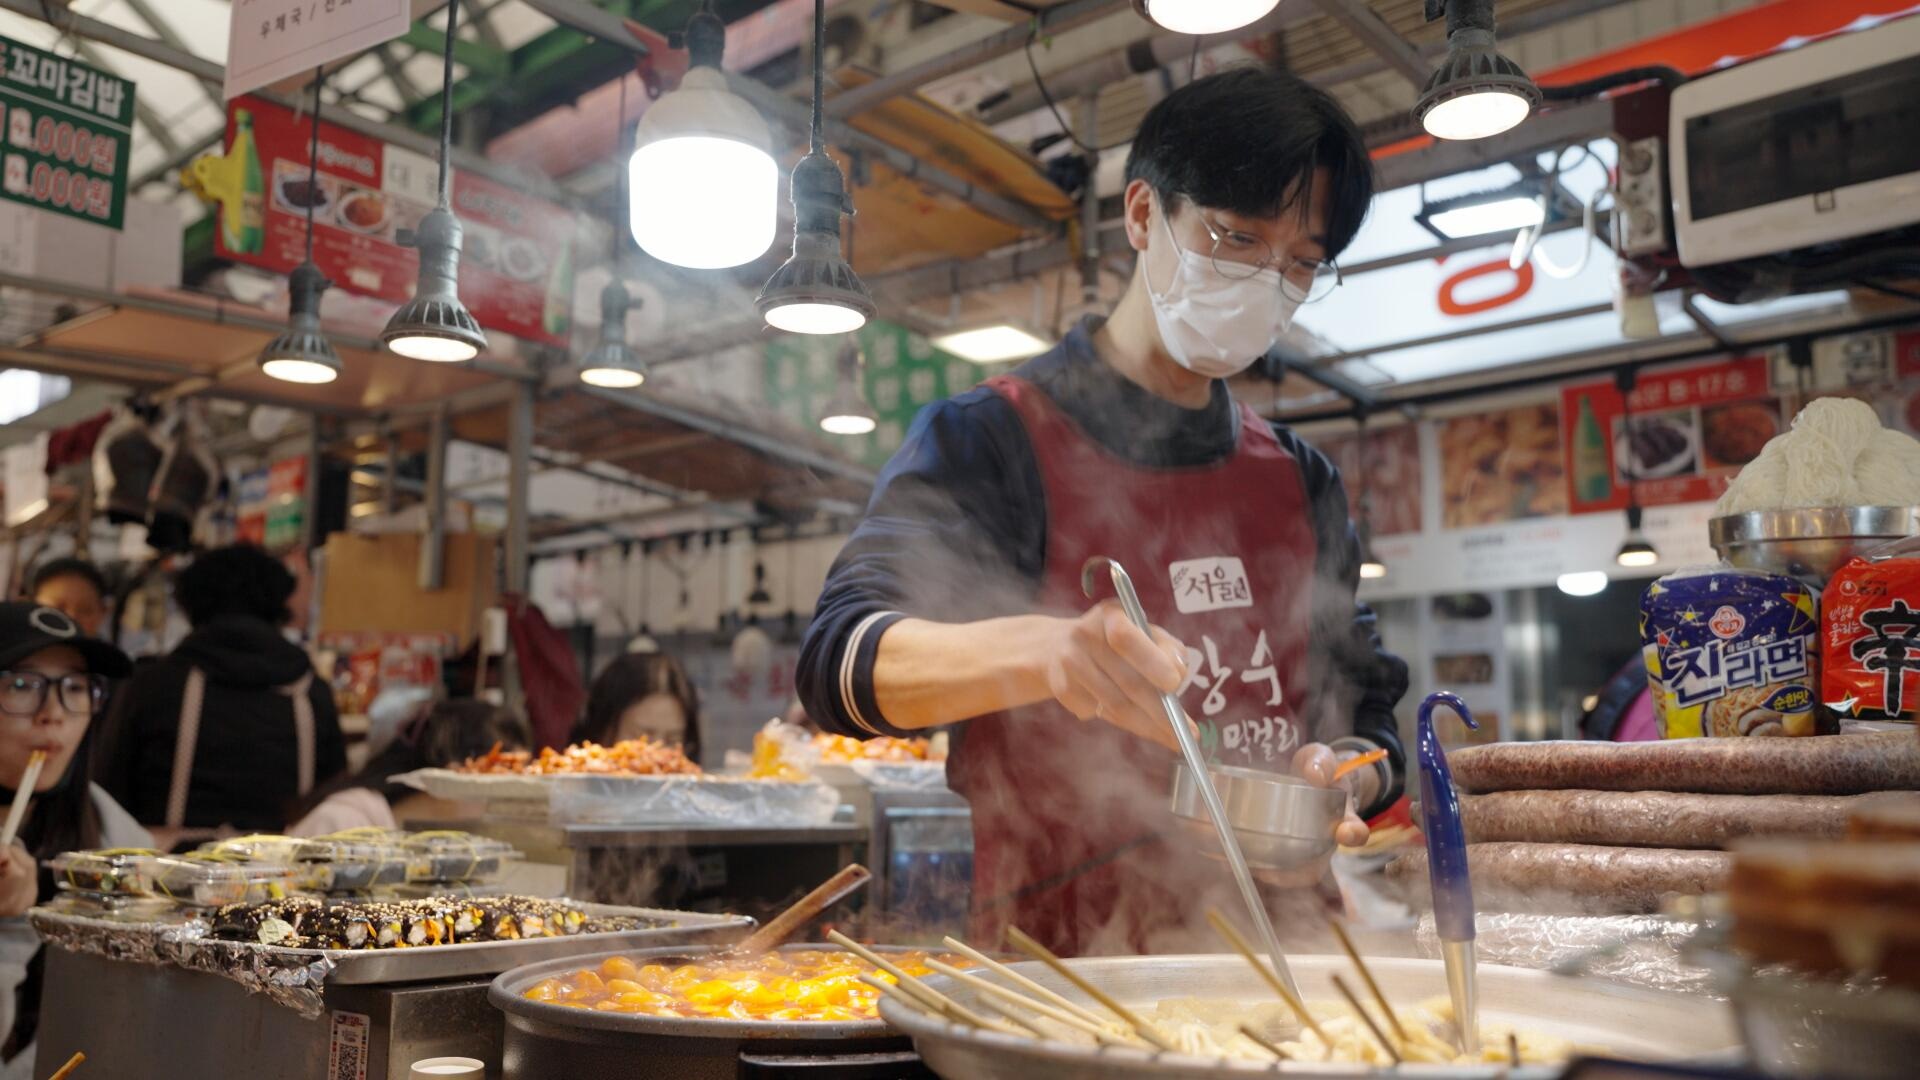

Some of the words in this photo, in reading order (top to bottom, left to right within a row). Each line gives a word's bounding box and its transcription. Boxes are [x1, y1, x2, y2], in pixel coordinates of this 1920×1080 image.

[0, 43, 124, 118] 꼬마김밥
[1176, 628, 1283, 716] 장수
[1666, 636, 1809, 709] 진라면
[1852, 599, 1920, 717] 辛
[1772, 689, 1809, 711] 순한맛
